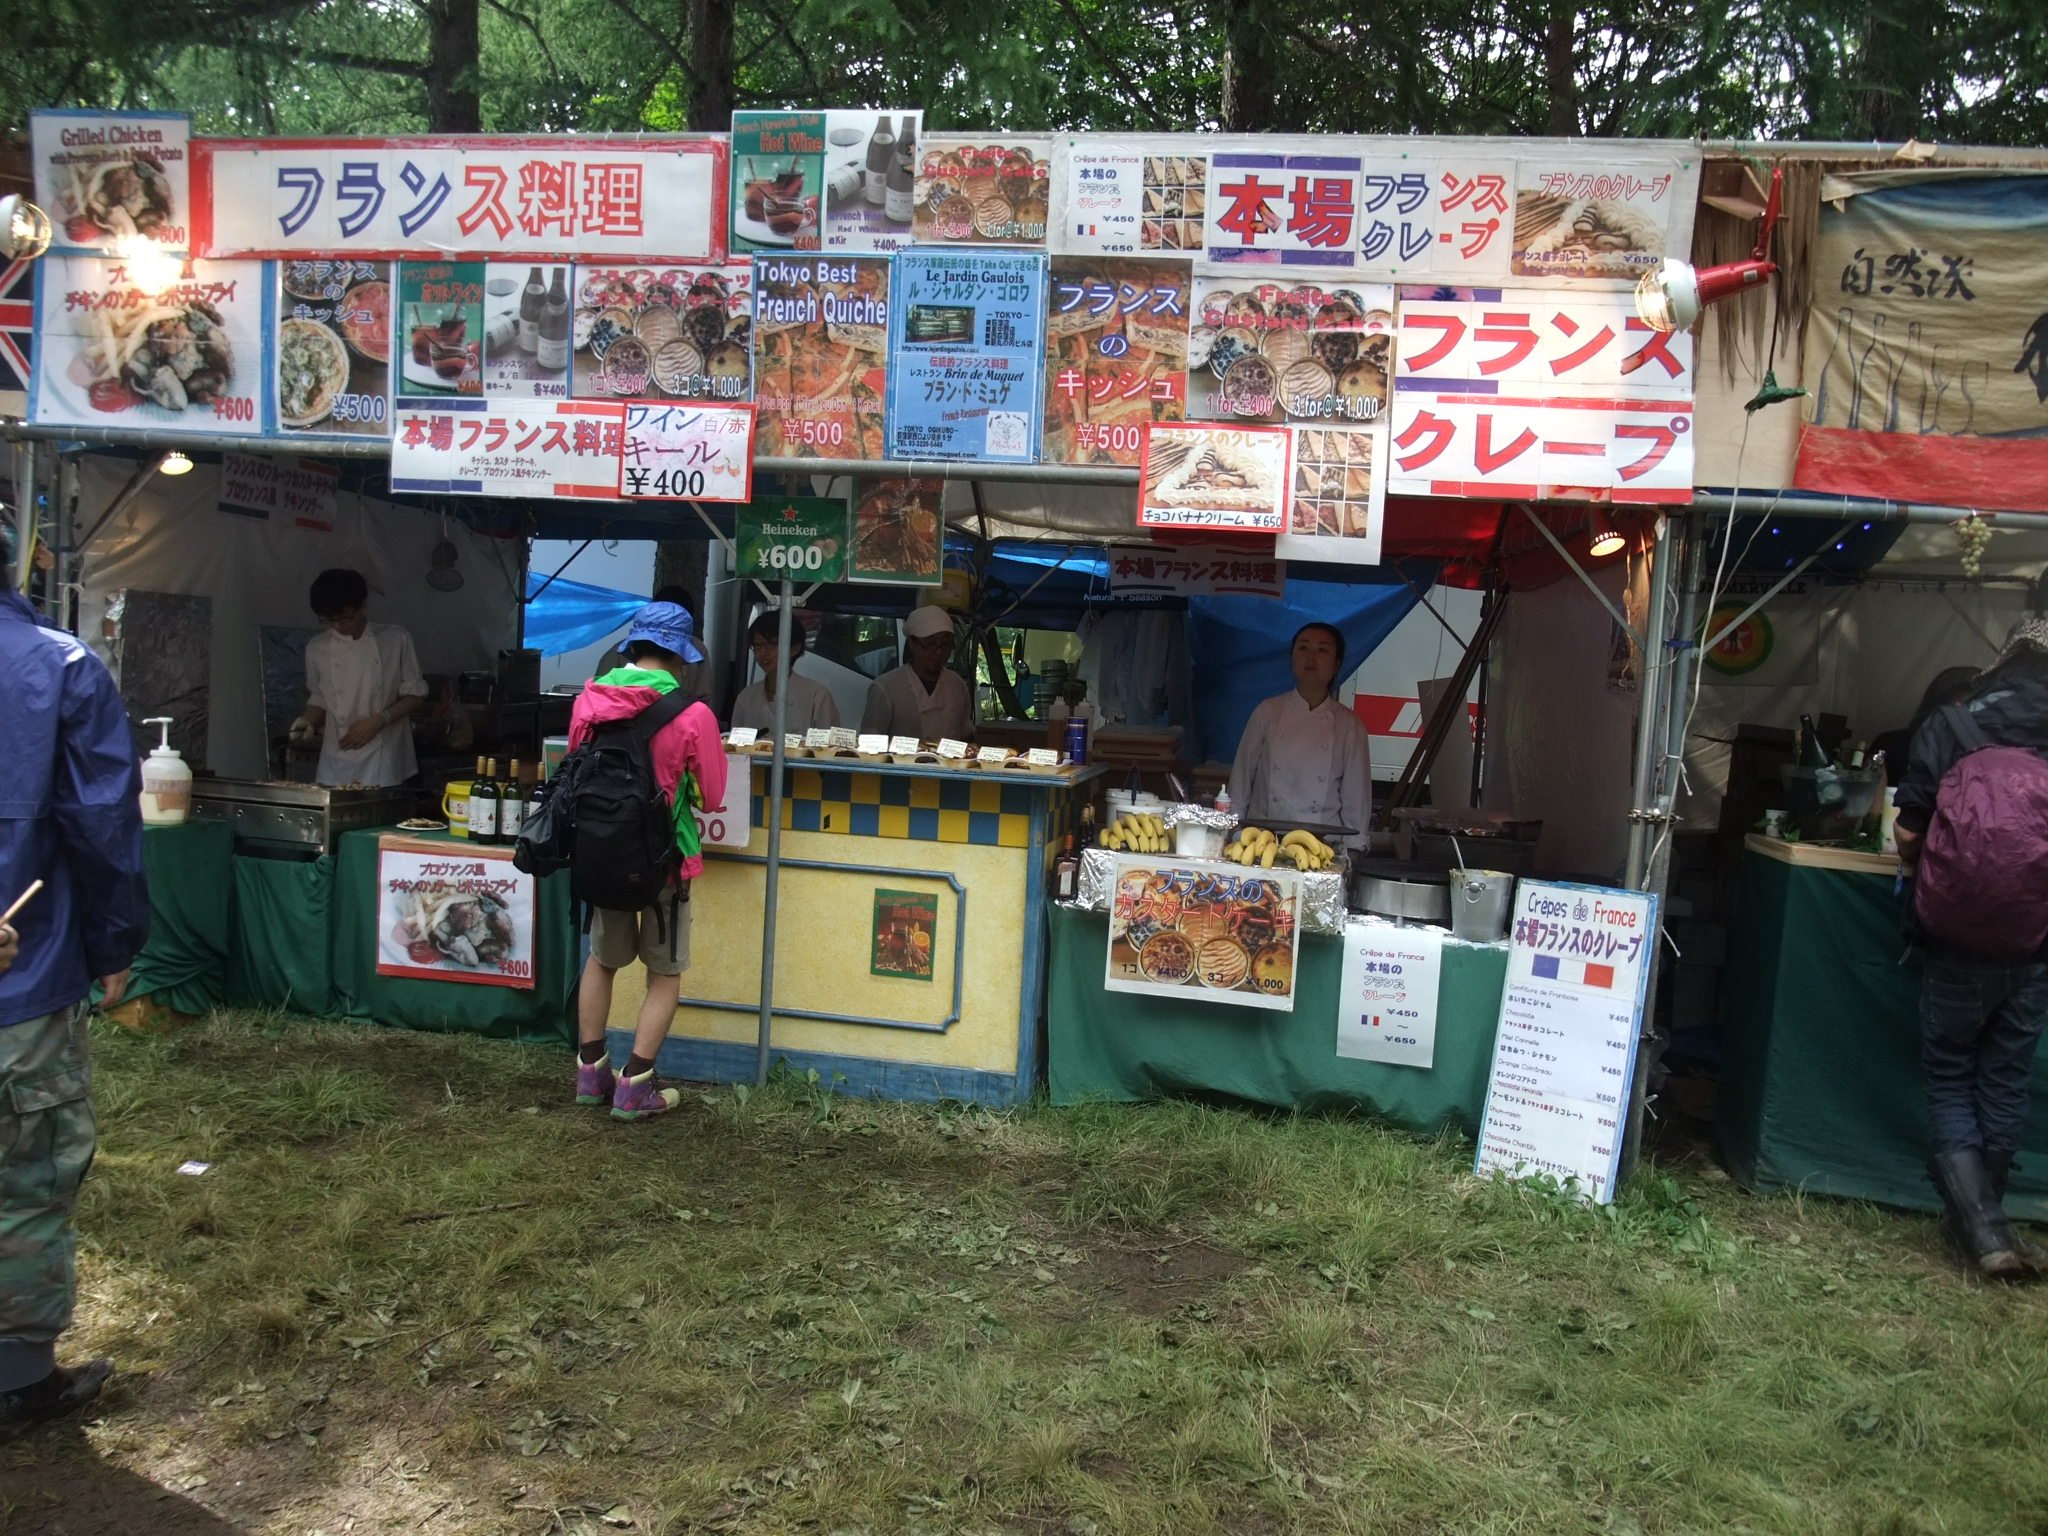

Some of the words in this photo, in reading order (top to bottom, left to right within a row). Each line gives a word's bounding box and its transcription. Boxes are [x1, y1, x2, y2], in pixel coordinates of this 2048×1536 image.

[61, 128, 104, 147] Grilled
[110, 126, 163, 144] Chicken
[760, 131, 785, 152] Hot
[789, 131, 823, 153] Wine
[1112, 156, 1139, 164] France
[1079, 168, 1117, 180] 本場の
[1078, 183, 1120, 195] フランス
[1364, 172, 1508, 214] フランス
[1539, 172, 1672, 202] フランスのクレープ
[278, 160, 644, 241] フランス料理
[1076, 198, 1122, 209] クレープ
[1216, 174, 1355, 248] 本場
[1102, 244, 1134, 252] ¥650
[1360, 217, 1500, 262] クレープ
[294, 259, 377, 280] フランス
[1624, 255, 1658, 264] ¥650
[758, 260, 811, 288] Tokyo
[816, 262, 857, 284] Best
[926, 270, 940, 282] Le
[942, 270, 978, 285] Jardin
[982, 271, 1024, 284] Gaulois
[324, 282, 345, 301] の
[908, 280, 1030, 302] ル・ジャルダン・ゴロワ
[1058, 284, 1180, 316] フランス
[1258, 285, 1336, 306] Fruits
[293, 304, 374, 323] キッシュ
[756, 290, 817, 322] French
[822, 290, 886, 325] Quiche
[1203, 310, 1310, 330] Custard
[1099, 335, 1128, 358] の
[1403, 312, 1686, 380] フランス
[910, 368, 942, 378] レストラン
[944, 368, 967, 380] Brin
[970, 369, 983, 380] de
[985, 370, 1024, 382] Muguet
[1056, 367, 1176, 402] キッシュ
[924, 380, 1011, 405] ブラン・ド・ミュゲ
[212, 396, 254, 422] ¥600
[332, 394, 386, 423] ¥500
[626, 404, 704, 432] ワイン
[703, 418, 746, 435] 白/赤
[400, 415, 622, 457] 本場フランス料理
[784, 420, 842, 445] ¥500
[1076, 423, 1140, 450] ¥500
[623, 436, 722, 466] キール
[1393, 409, 1690, 482] クレープ
[626, 468, 704, 497] ¥400
[762, 523, 817, 536] Heineken
[1143, 509, 1244, 526] チョコバナナクリーム
[1252, 515, 1283, 528] ¥650
[758, 545, 822, 570] ¥600
[1116, 556, 1277, 584] 本場フランス料理
[694, 818, 726, 842] 00
[1156, 869, 1264, 904] フランスの
[1114, 894, 1295, 936] カスタードケーキ
[1528, 892, 1568, 918] Crêpes
[1572, 898, 1588, 921] de
[1594, 900, 1636, 928] France
[1515, 916, 1643, 964] 本場フランスのクレープ
[1360, 948, 1383, 958] Crêpe
[1398, 951, 1424, 961] France
[498, 959, 529, 976] ¥600
[1157, 967, 1188, 978] ¥400
[1365, 961, 1403, 975] 本場の
[1364, 975, 1405, 990] フランス
[1362, 989, 1406, 1002] クレープ
[1387, 1008, 1418, 1018] ¥450
[1609, 1013, 1630, 1023] ¥450
[1384, 1035, 1416, 1045] ¥650
[1606, 1040, 1626, 1050] ¥450
[1601, 1066, 1622, 1076] ¥450
[1595, 1092, 1616, 1104] ¥500
[1592, 1144, 1611, 1156] ¥500
